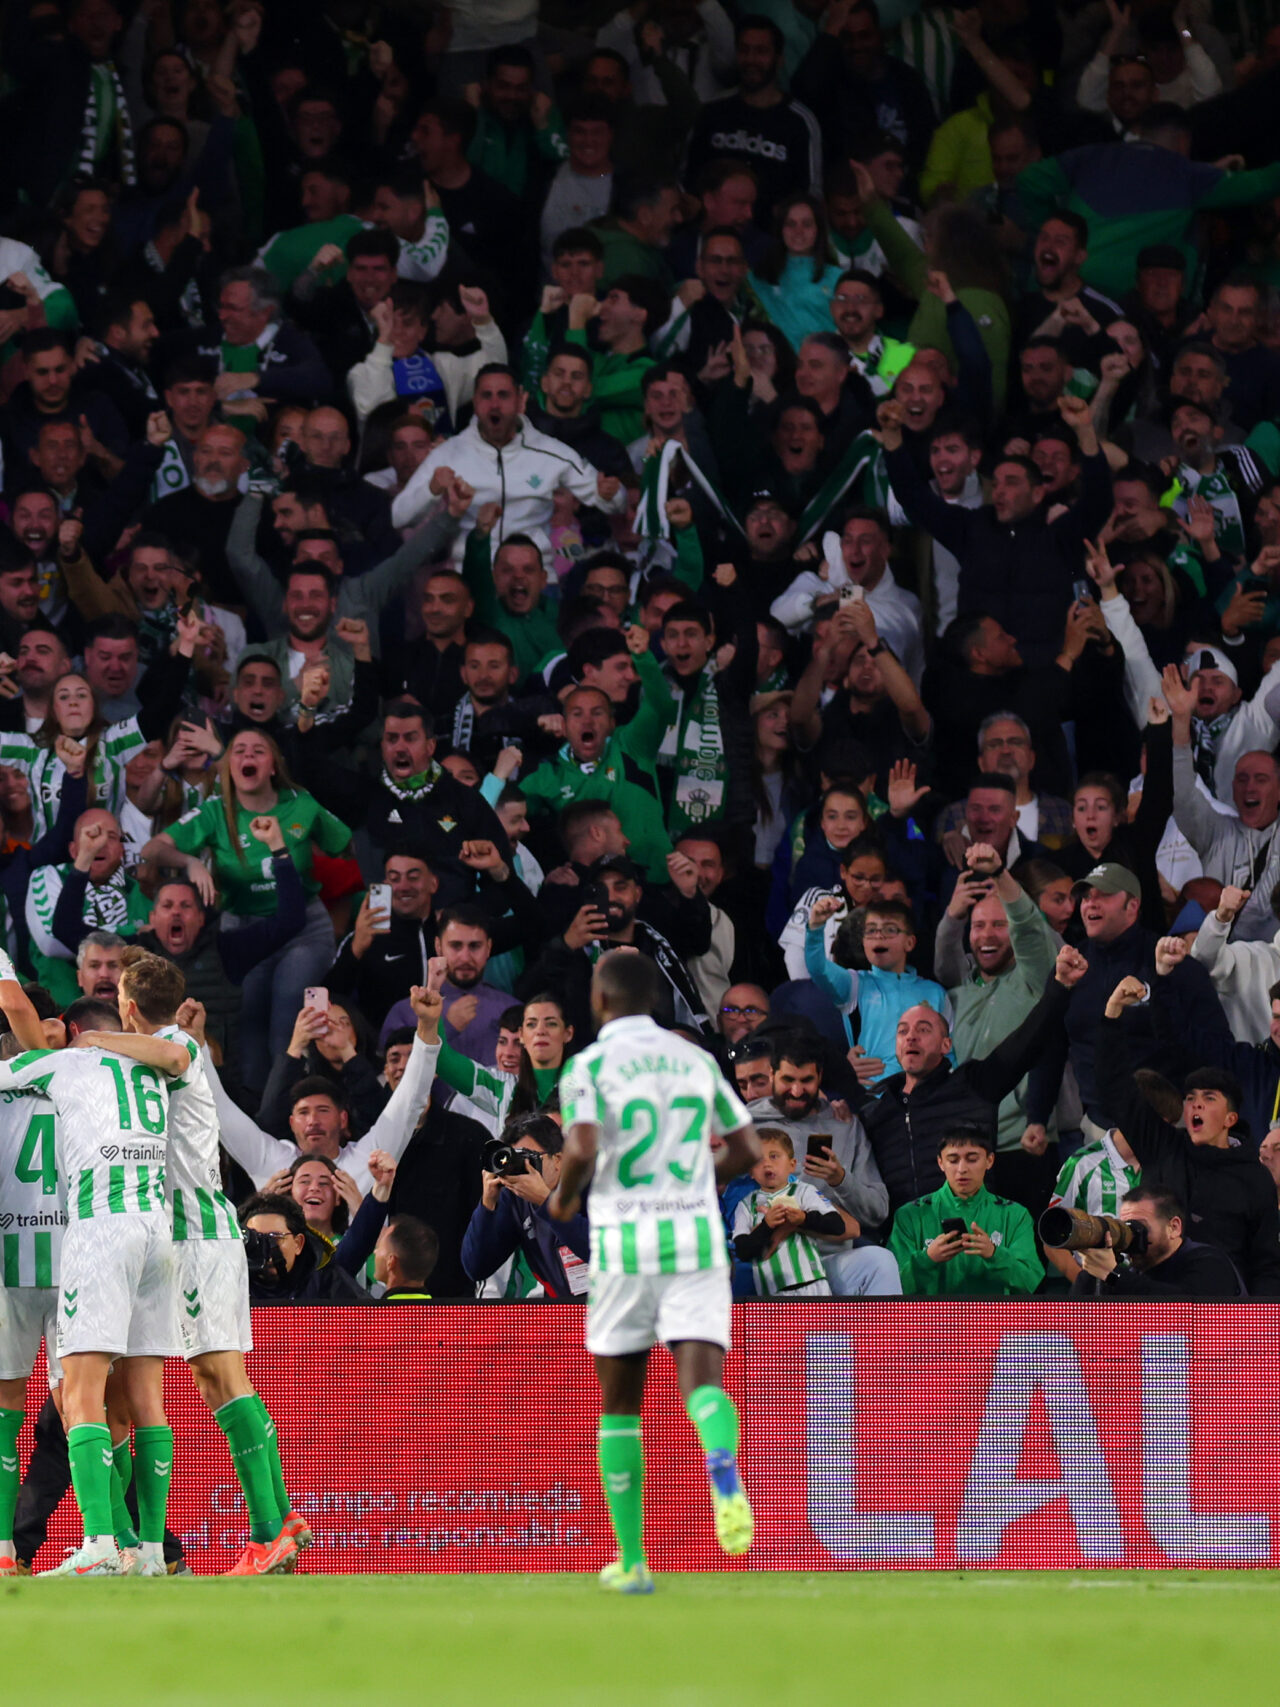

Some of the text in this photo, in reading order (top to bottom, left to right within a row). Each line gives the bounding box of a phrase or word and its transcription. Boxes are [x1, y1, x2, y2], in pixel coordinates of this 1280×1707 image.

[711, 129, 787, 162] adidas
[100, 1057, 166, 1135] 16
[14, 1114, 59, 1195] 4
[617, 1096, 706, 1190] 23
[805, 1330, 1271, 1560] LAL
